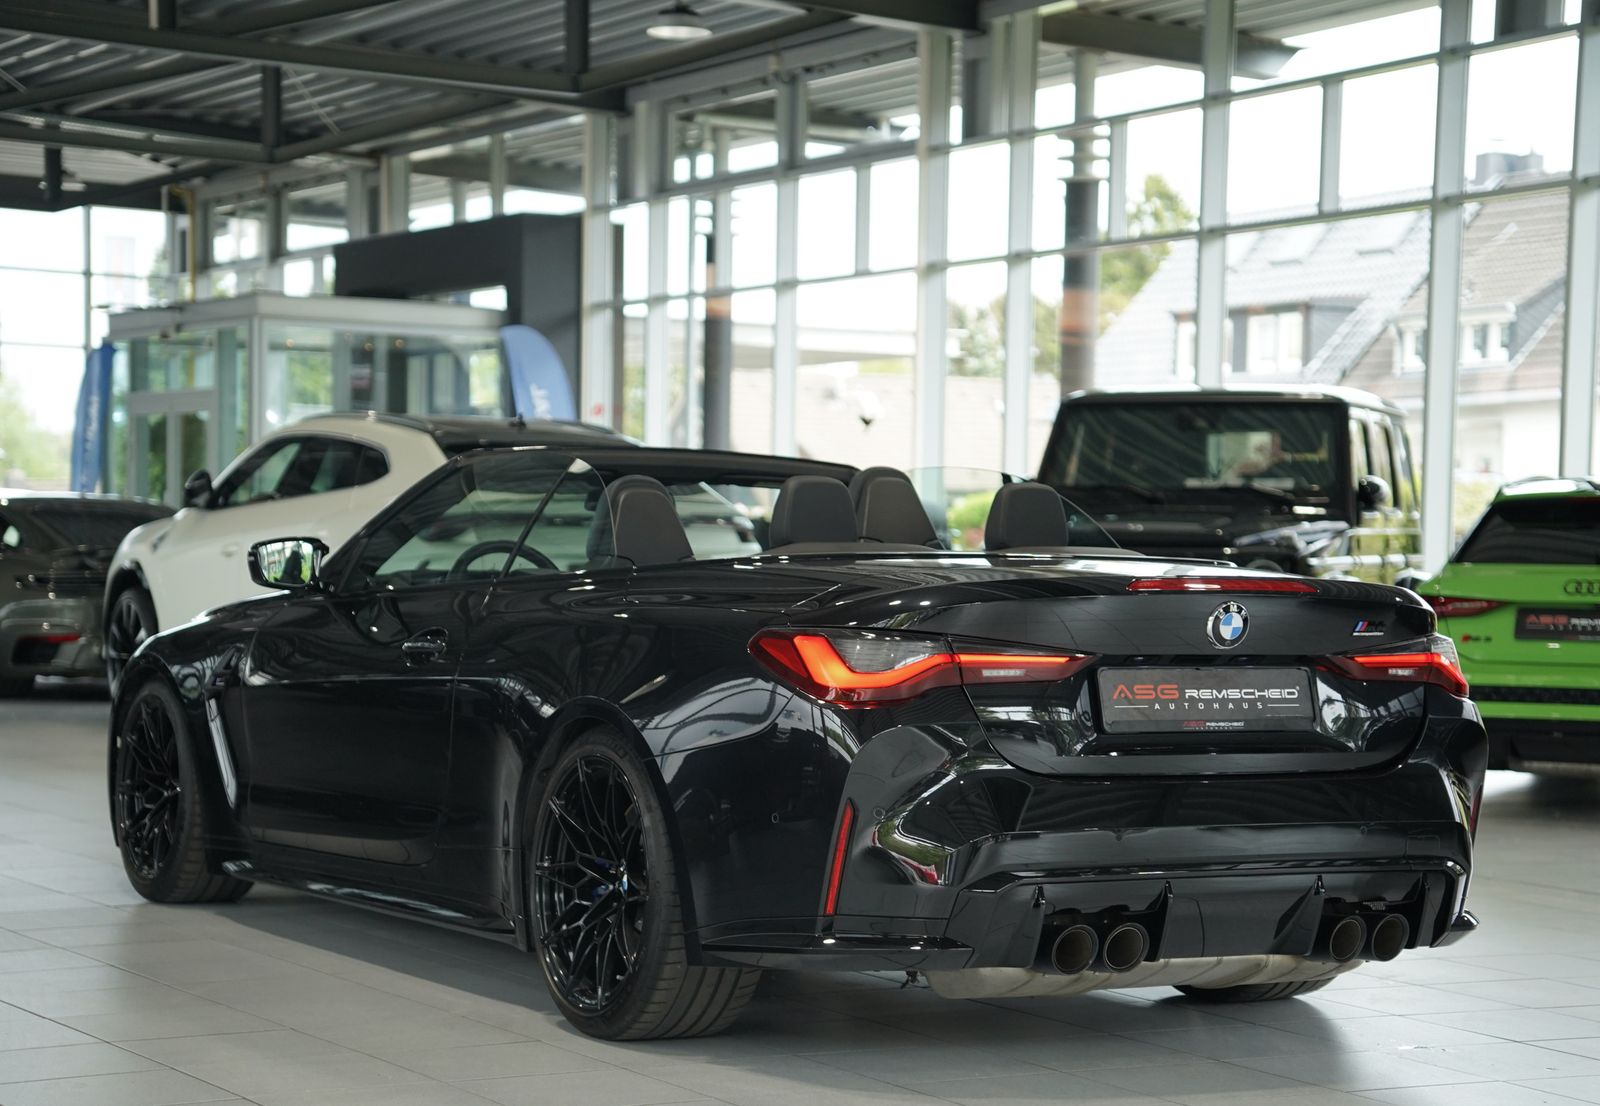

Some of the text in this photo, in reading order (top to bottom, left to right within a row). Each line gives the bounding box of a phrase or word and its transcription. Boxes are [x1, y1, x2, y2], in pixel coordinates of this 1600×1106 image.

[1217, 604, 1248, 619] BMW
[1112, 684, 1299, 700] ASG REMSCHEID
[1154, 702, 1263, 710] AUTOHAUS
